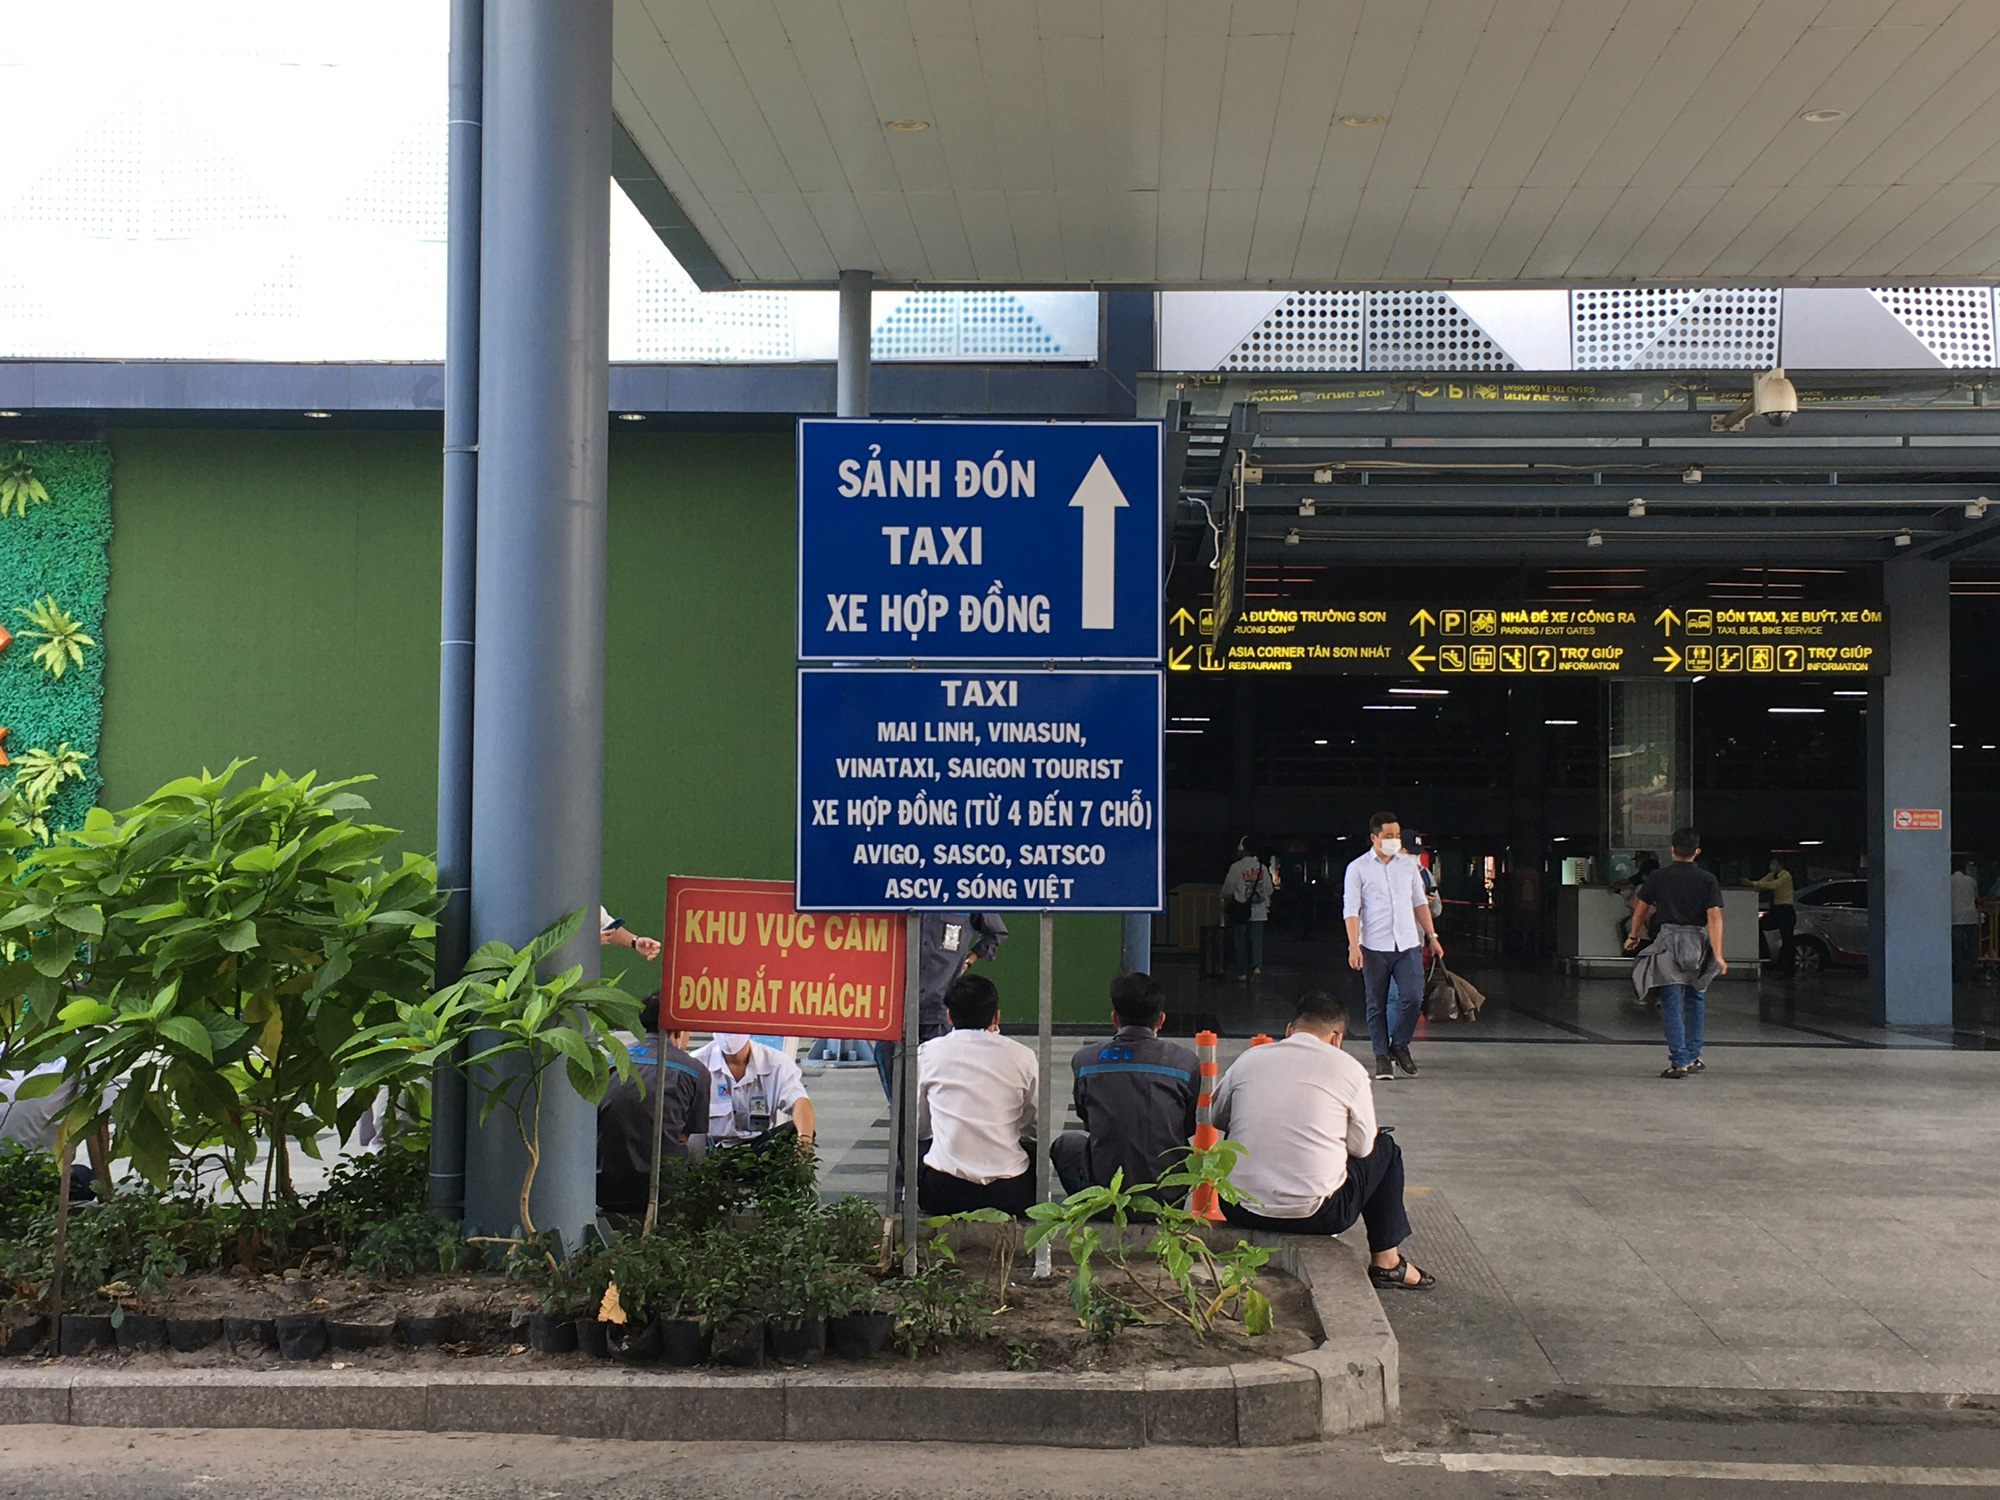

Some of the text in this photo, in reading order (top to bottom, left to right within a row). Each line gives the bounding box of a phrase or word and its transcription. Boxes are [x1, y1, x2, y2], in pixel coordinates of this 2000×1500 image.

[838, 444, 1036, 498] SẢNH ĐÓN
[882, 526, 982, 565] TAXI
[826, 580, 1050, 642] XE HỢP ĐỒNG
[1238, 608, 1387, 622] A ĐƯỜNG TRƯỜNG SƠN
[1501, 609, 1529, 623] NHÀ
[1551, 612, 1568, 623] XE
[1570, 612, 1575, 623] /
[1618, 613, 1636, 623] RA
[1716, 609, 1882, 624] ĐÓN TAXI, XE BUÝT, XE ÔM
[1501, 627, 1539, 635] PARKING
[1545, 627, 1564, 635] EXIT
[1566, 627, 1595, 635] GATES
[1762, 627, 1782, 635] BIKE
[1784, 627, 1823, 635] SERVICE
[1228, 646, 1255, 657] ASIA
[1257, 646, 1305, 657] CORNER
[1307, 644, 1330, 657] TÂN
[1332, 647, 1358, 658] SƠN
[1559, 645, 1624, 660] TRỢ GIÚP
[1807, 645, 1873, 661] TRỢ GIÚP
[1228, 661, 1292, 670] RESTAURANTS
[1559, 662, 1619, 670] INFORMATION
[1807, 662, 1869, 671] INFORMATION
[941, 680, 1018, 707] TAXI
[878, 722, 1087, 747] MAI LINH, VINASUN,
[836, 758, 1123, 782] VINATAXI, SAIGON TOURIST
[812, 789, 1152, 832] XE HỢP ĐỒNG (TỪ 4 ĐẾN 7 CHỖ)
[853, 844, 1105, 869] AVIGO, SASCO, SATSCO
[885, 873, 1074, 903] ASCV, SÓNG VIỆT
[684, 909, 746, 946] KHU
[756, 912, 815, 958] VỰC
[679, 967, 729, 1012] ĐÓN
[736, 964, 782, 1013] BẮT
[789, 973, 872, 1018] KHÁCH
[627, 1046, 648, 1055] CV
[1099, 1047, 1134, 1060] ACV
